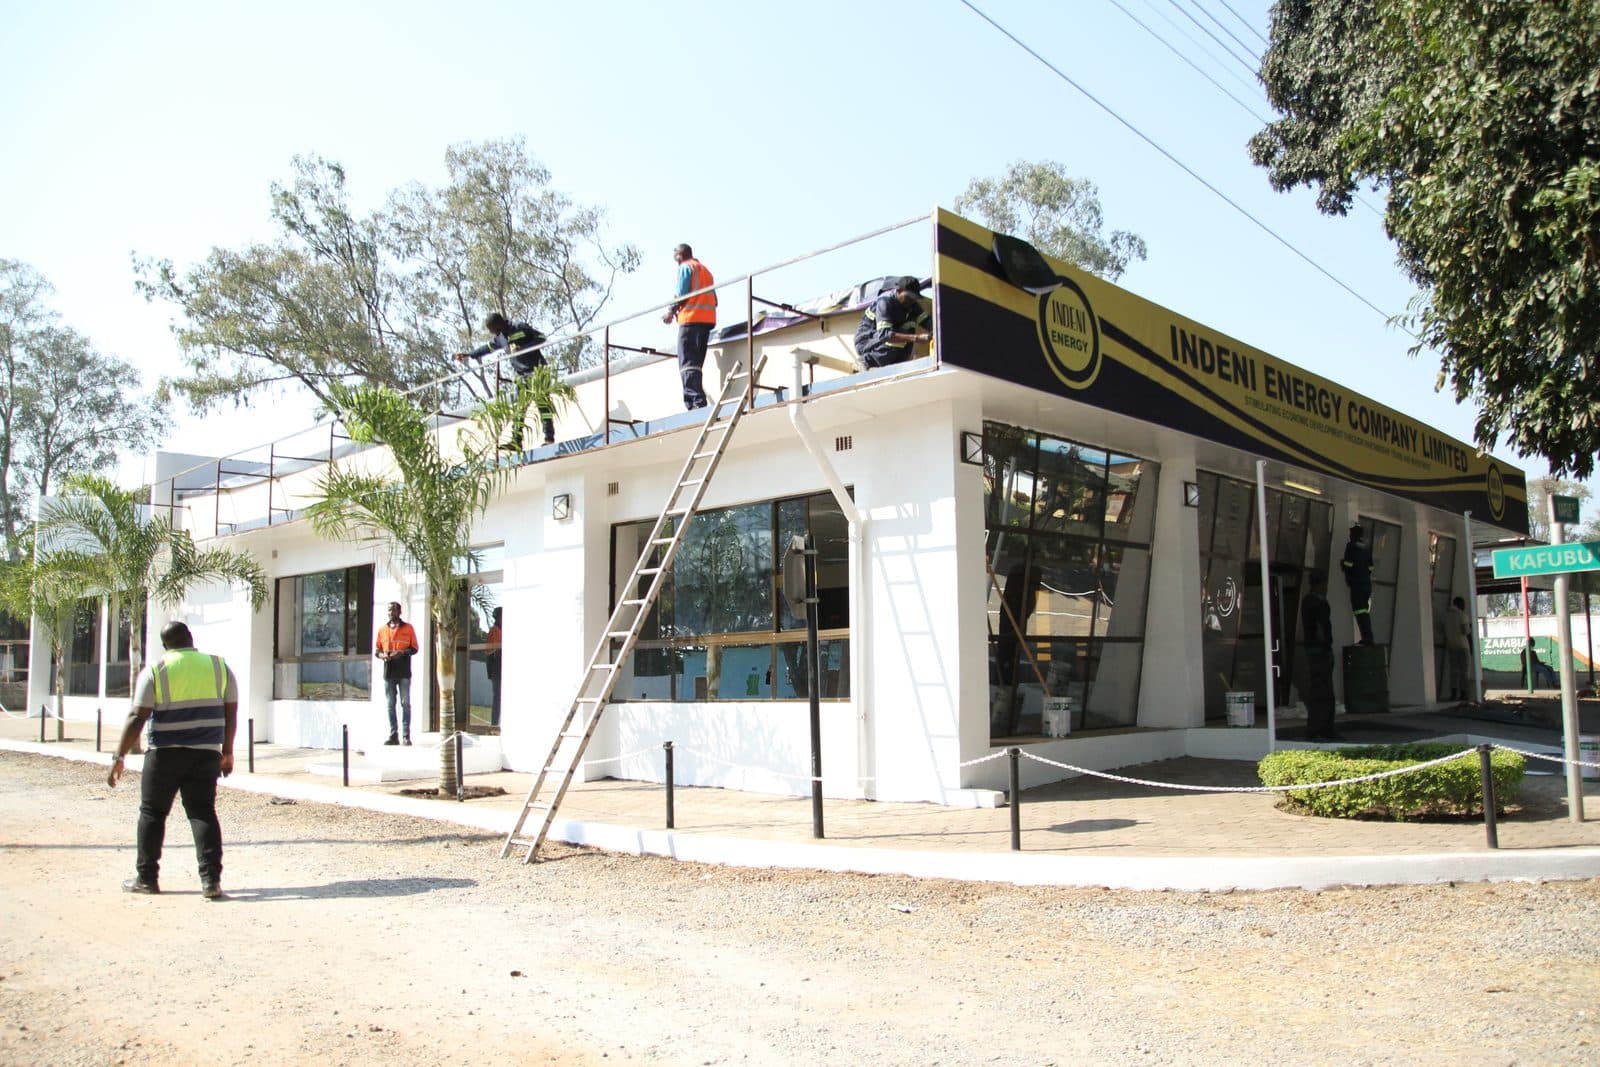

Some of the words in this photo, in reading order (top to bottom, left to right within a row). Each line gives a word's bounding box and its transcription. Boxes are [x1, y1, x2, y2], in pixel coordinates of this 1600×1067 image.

[1052, 300, 1086, 334] INDENI
[1051, 332, 1088, 353] ENERGY
[1170, 325, 1257, 392] INDENI
[1264, 365, 1342, 424] ENERGY
[1348, 401, 1418, 453] COMPANY
[1421, 433, 1468, 473] LIMITED
[1509, 550, 1593, 570] KAFUBU
